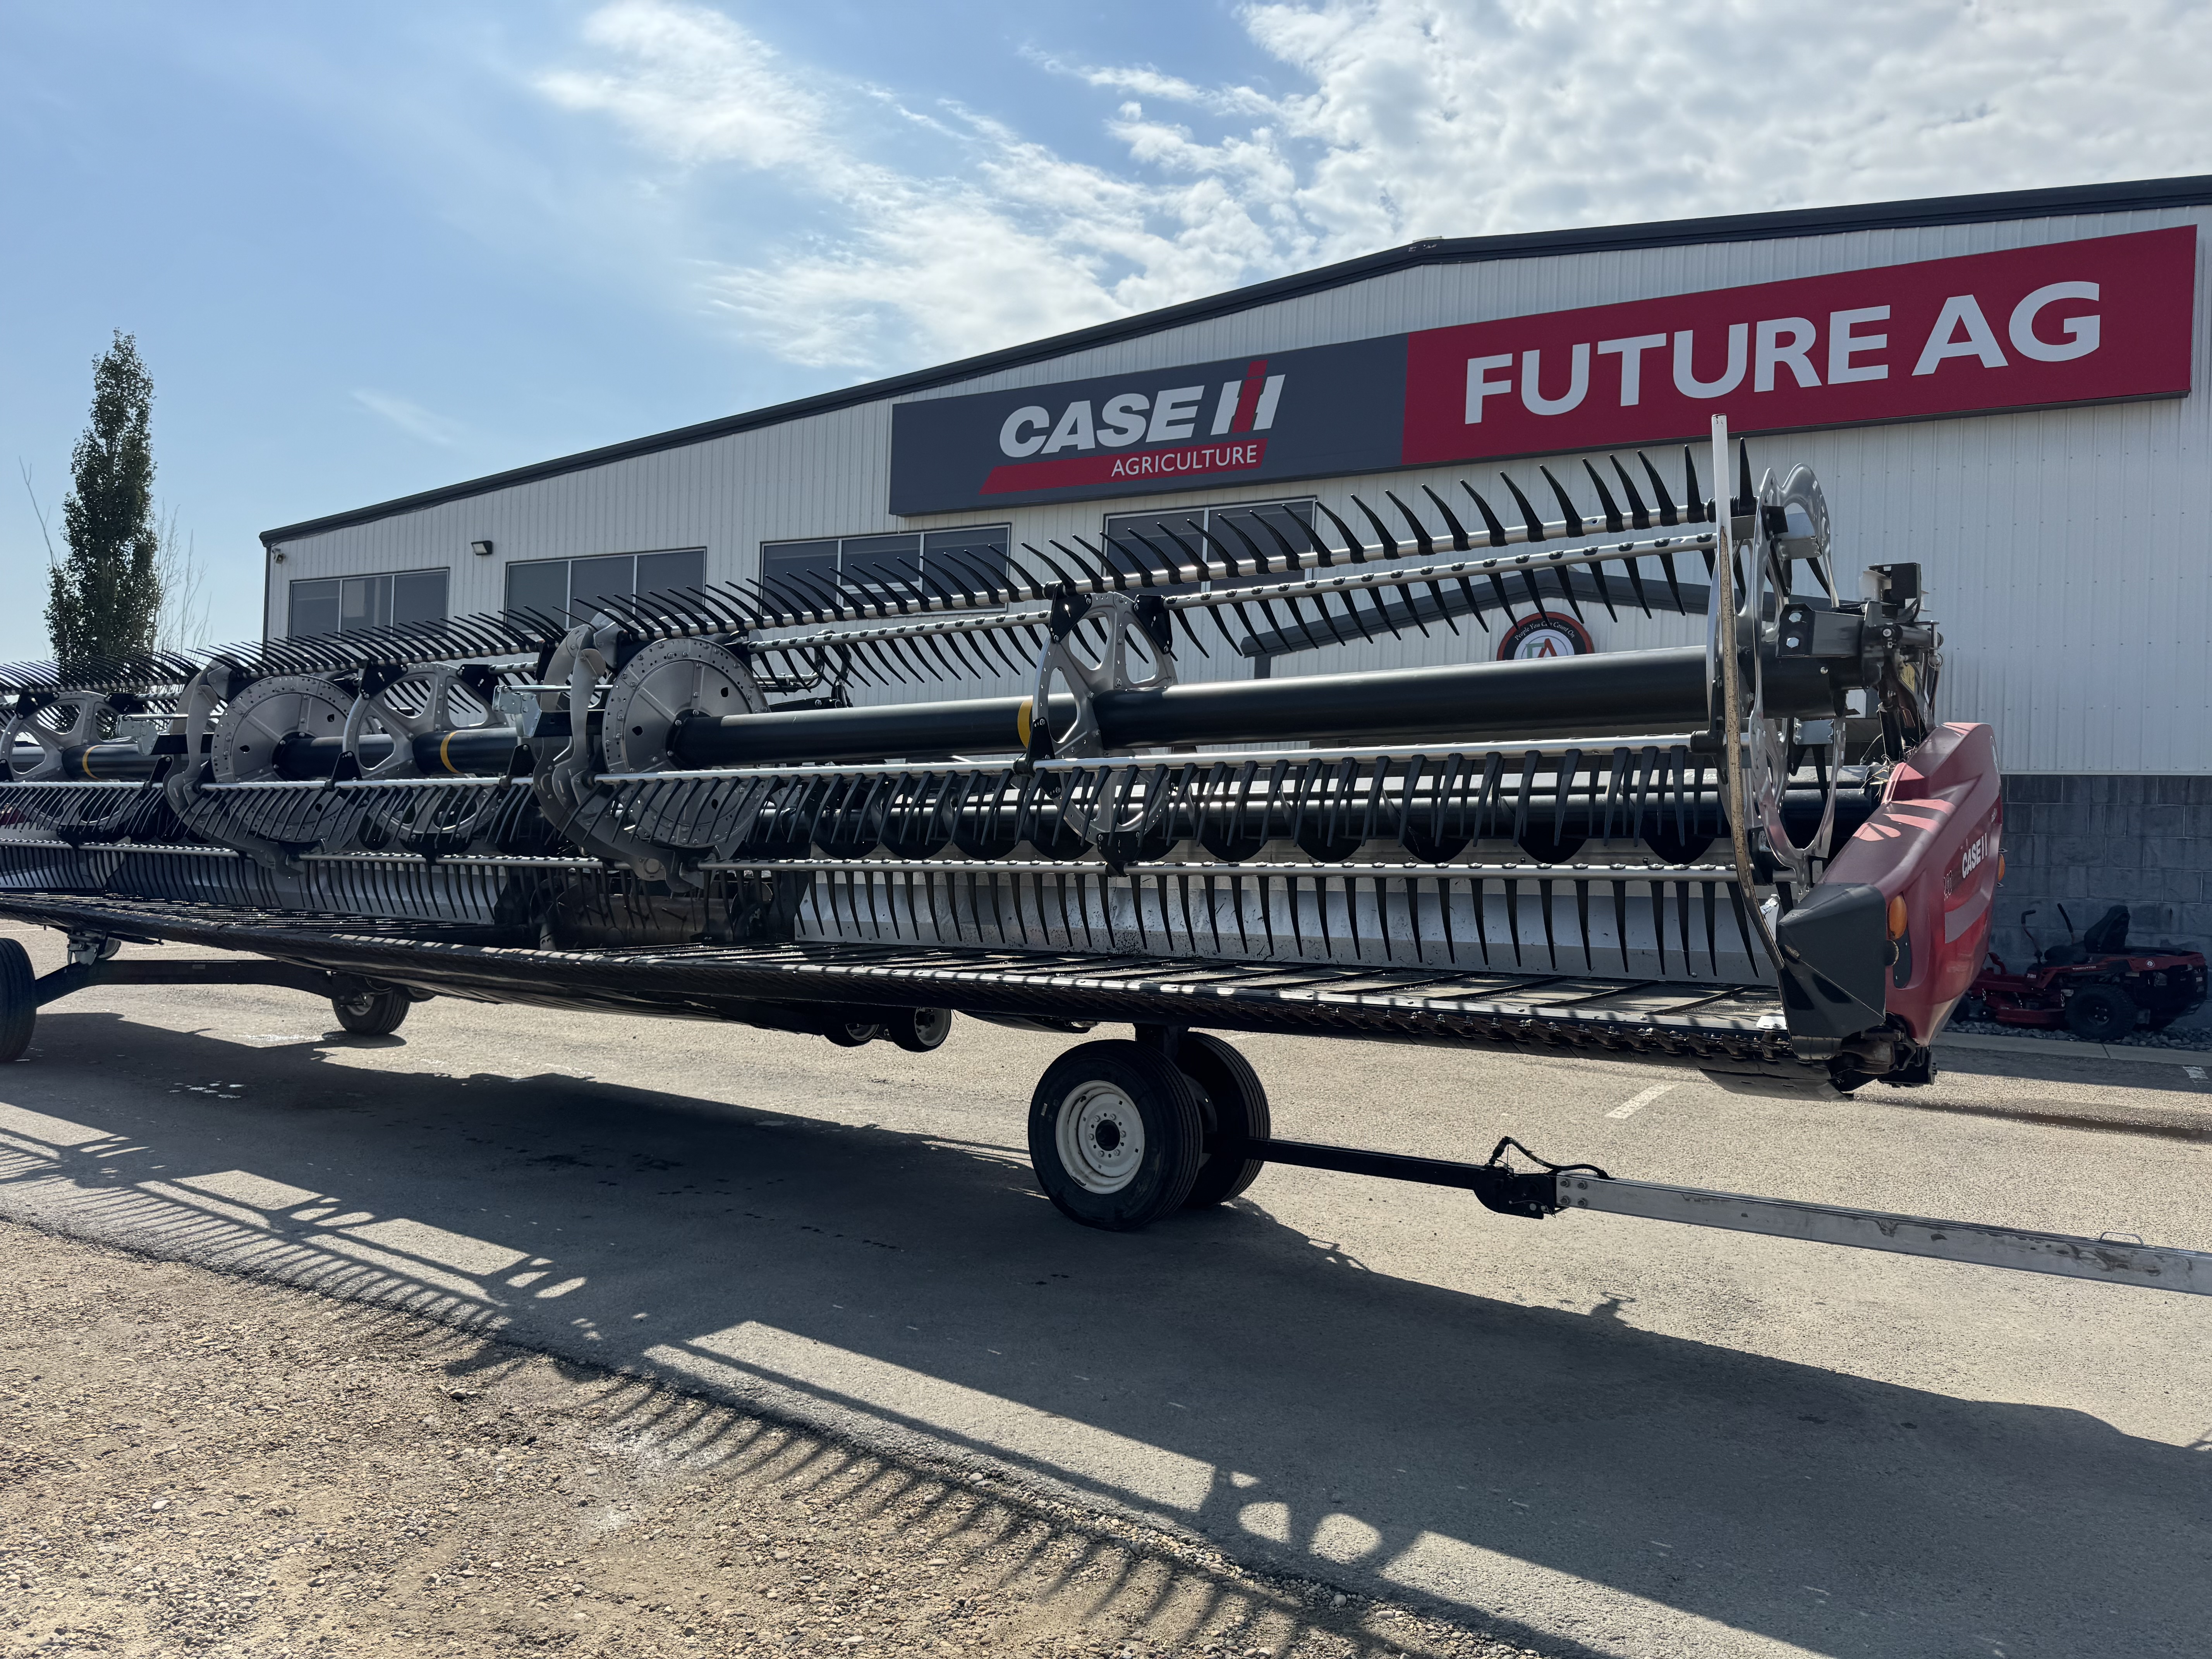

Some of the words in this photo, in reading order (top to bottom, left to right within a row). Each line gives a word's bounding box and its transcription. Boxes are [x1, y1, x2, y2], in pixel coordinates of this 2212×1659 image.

[1465, 305, 1890, 424] FUTURE
[1911, 281, 2100, 376] AG
[1000, 385, 1204, 458] CASE
[1111, 444, 1257, 477] AGRICULTURE
[1515, 627, 1530, 641] People
[1553, 622, 1569, 632] Count
[1568, 630, 1575, 638] On
[1962, 838, 1982, 879] CASE
